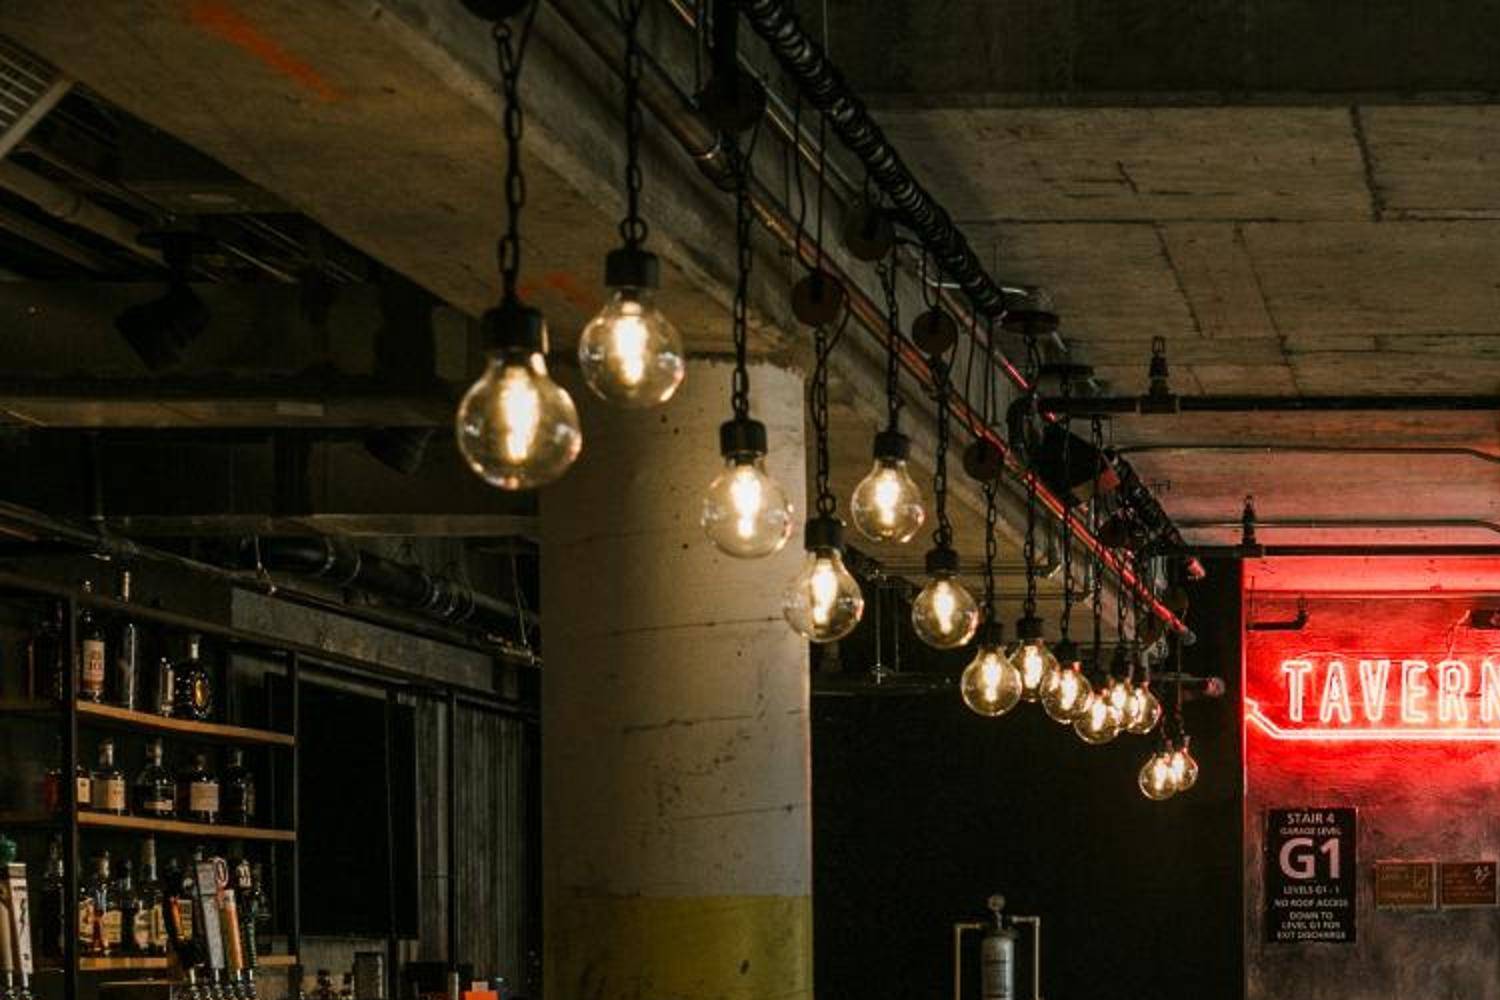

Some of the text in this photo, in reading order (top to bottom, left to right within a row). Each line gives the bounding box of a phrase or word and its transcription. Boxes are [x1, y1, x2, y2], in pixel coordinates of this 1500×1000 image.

[1287, 812, 1323, 825] STAIR
[1279, 837, 1341, 880] G1
[1320, 911, 1333, 921] TO
